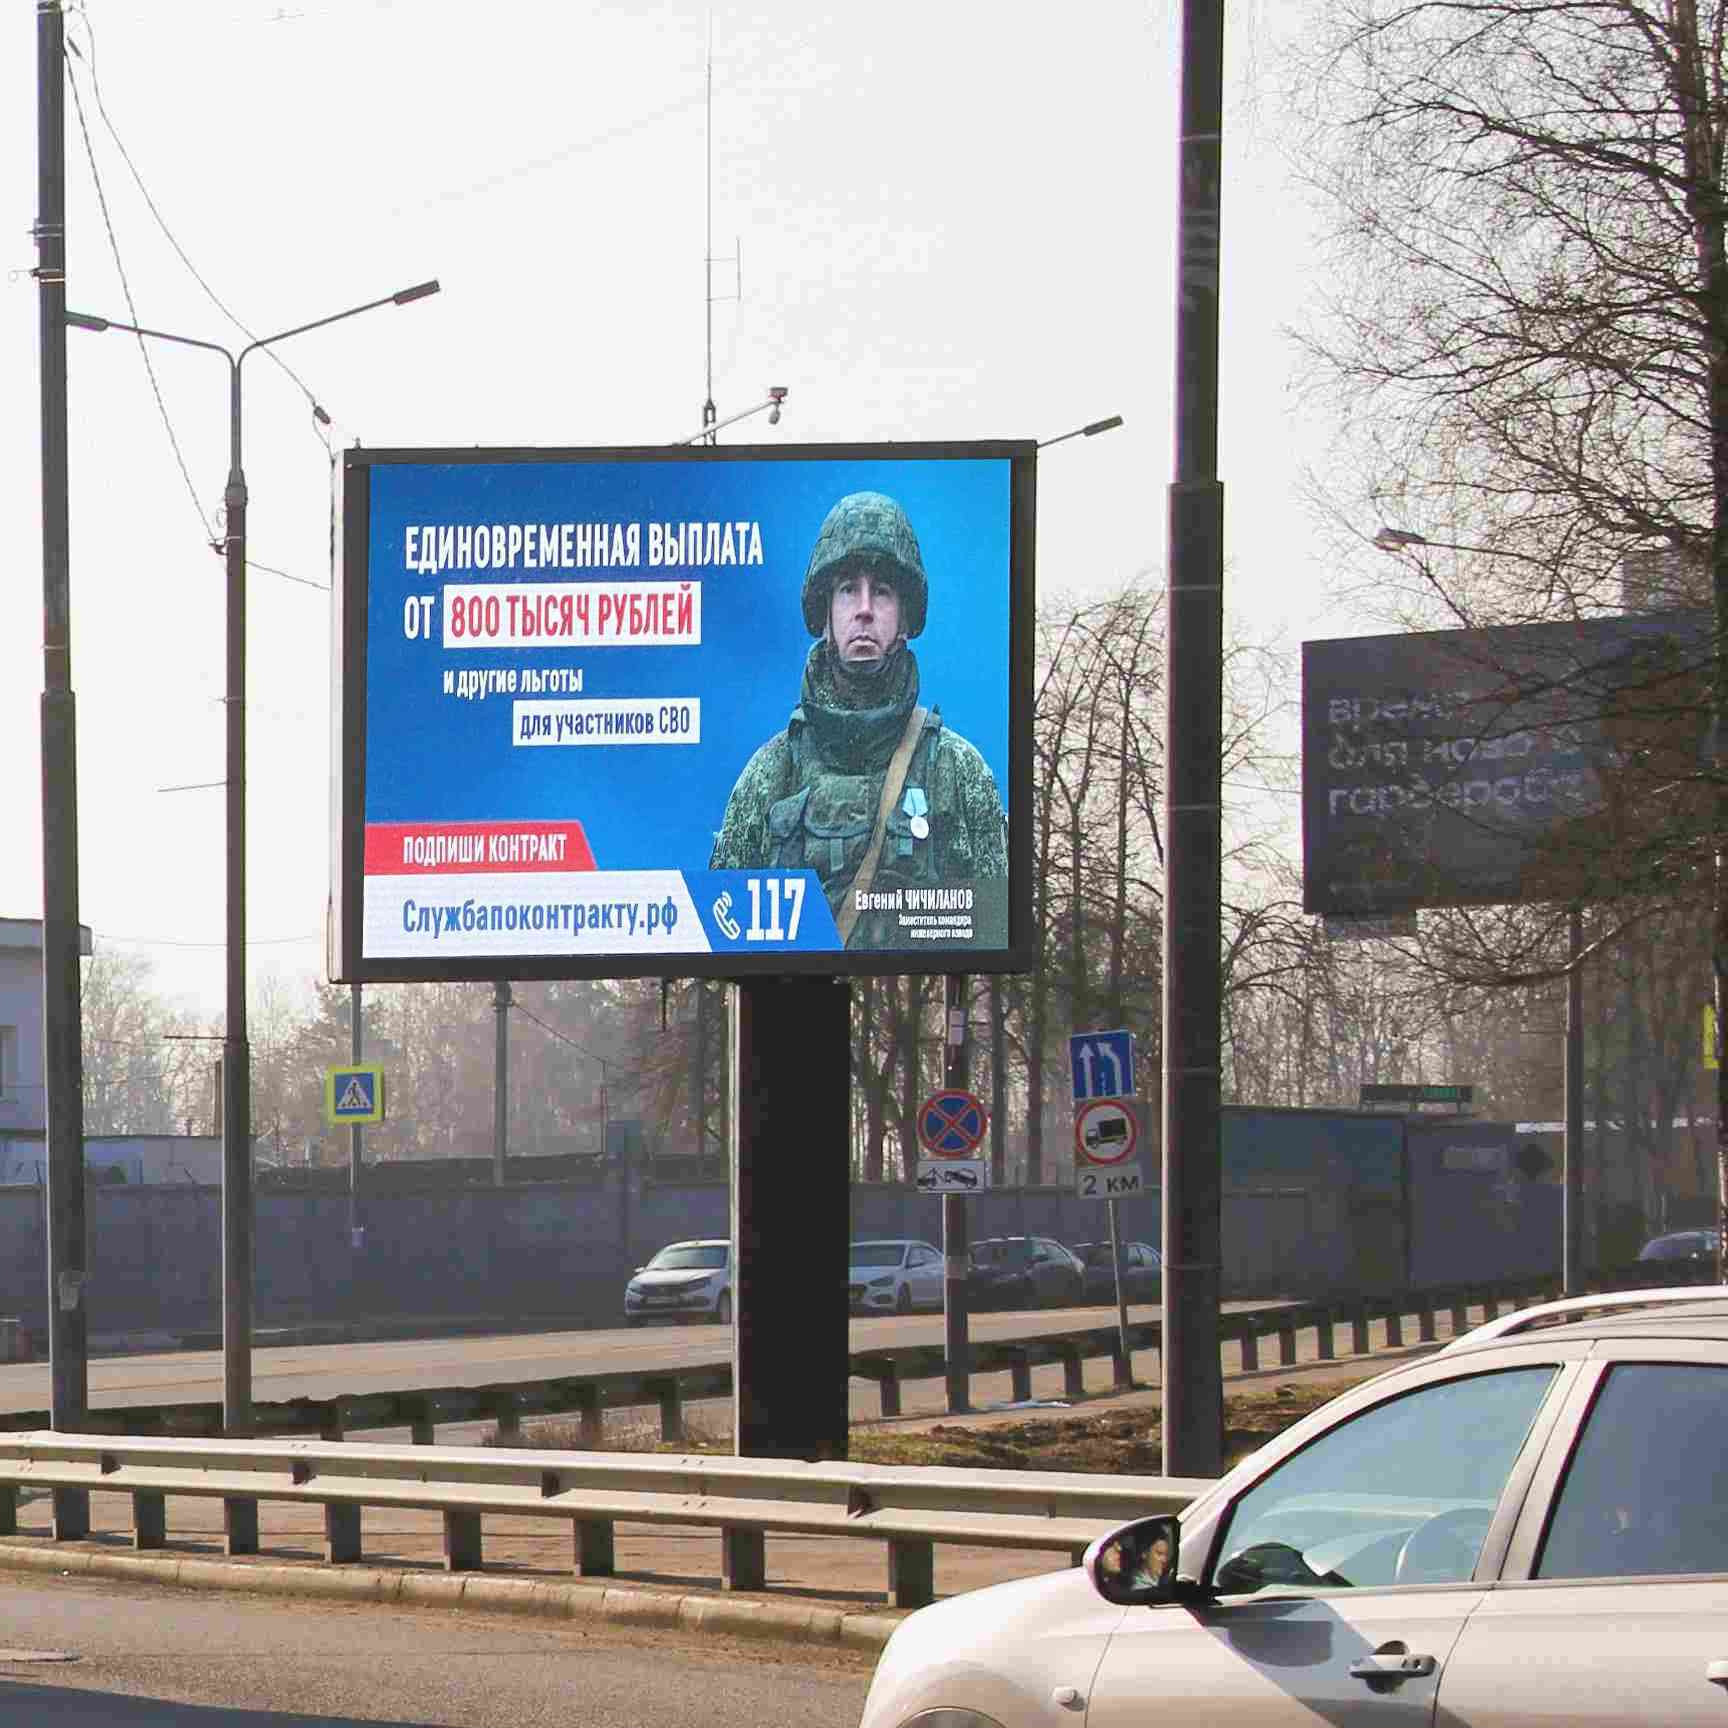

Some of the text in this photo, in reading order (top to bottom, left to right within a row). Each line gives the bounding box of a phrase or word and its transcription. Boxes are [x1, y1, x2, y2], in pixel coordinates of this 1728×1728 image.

[405, 522, 763, 574] ЕДИНОВРЕМЕННАЯ ВЫПЛАТА
[404, 583, 693, 640] ОТ 800 ТЫСЯЧ РУБЛЕЙ
[443, 669, 583, 699] и другие льготы
[521, 706, 690, 742] для участников СВО
[403, 833, 567, 866] ПОДПИШИ КОНТРАКТ
[402, 896, 678, 939] Службапоконтракту.рф
[746, 878, 805, 941] 117
[855, 888, 903, 911] Евгений
[1083, 1175, 1098, 1195] 2
